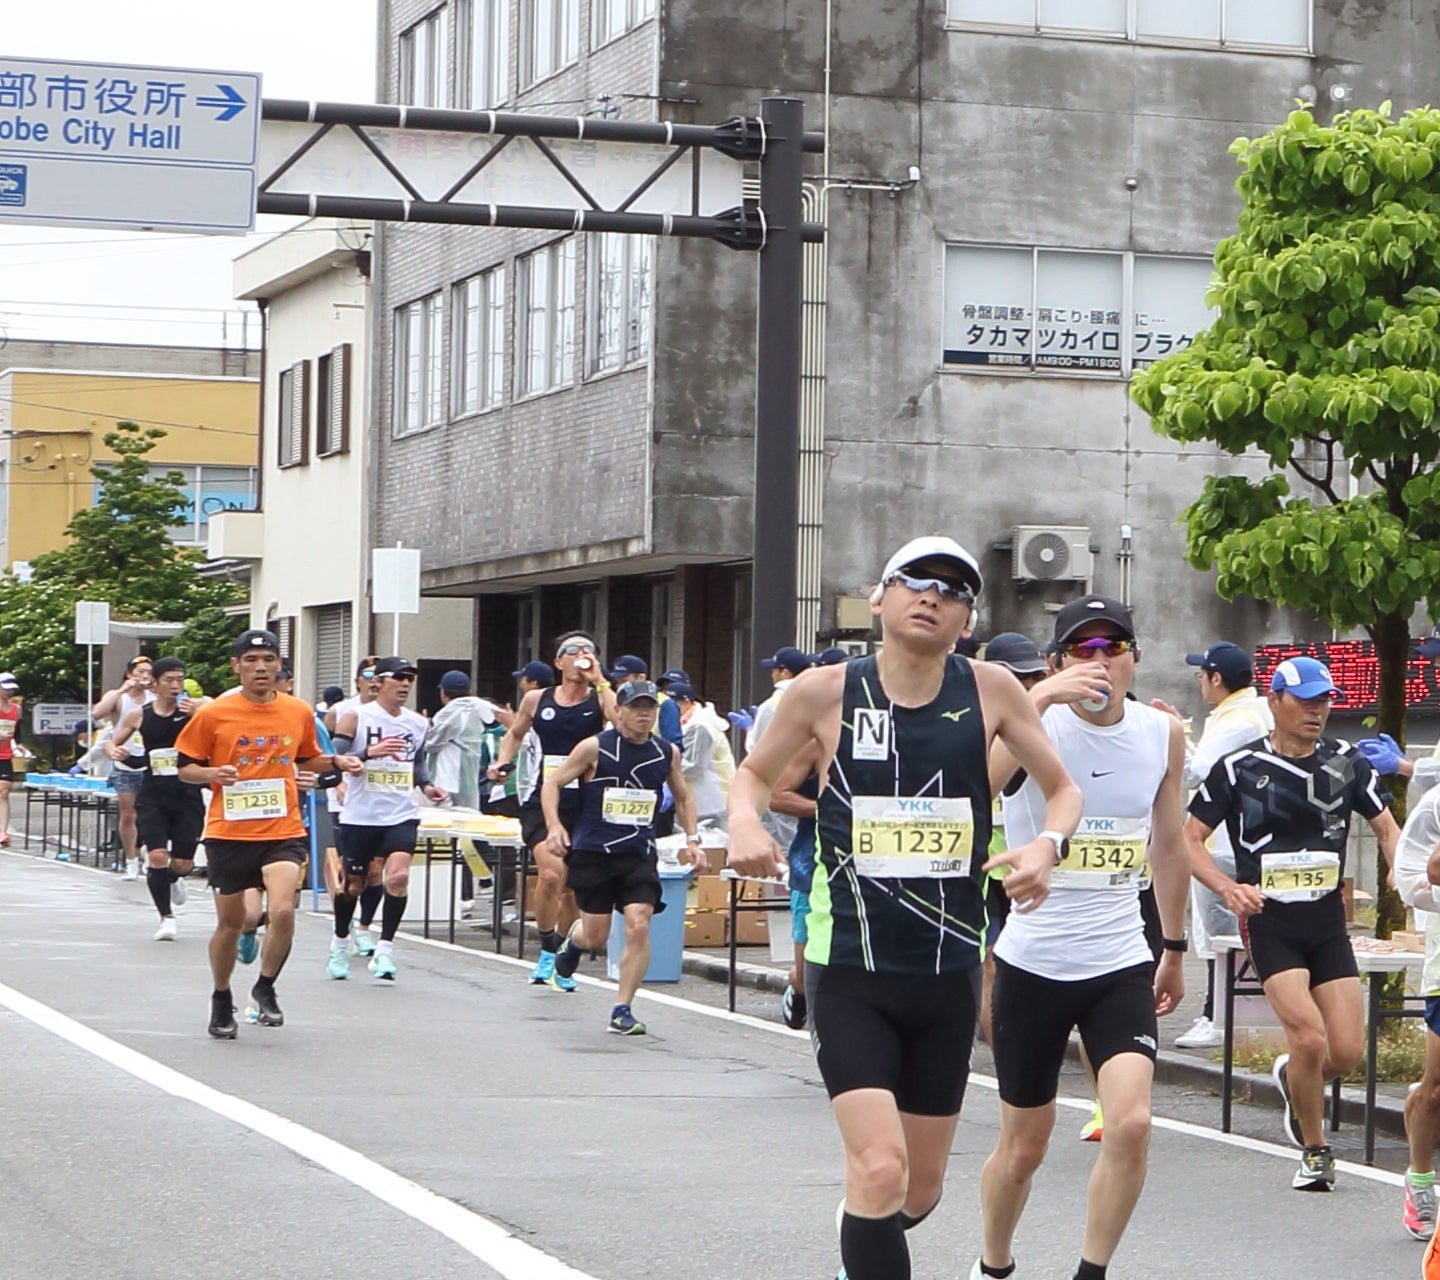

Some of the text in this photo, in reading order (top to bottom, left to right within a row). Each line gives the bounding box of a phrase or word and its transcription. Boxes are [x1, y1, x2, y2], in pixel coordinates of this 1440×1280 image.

[63, 117, 116, 151] City
[129, 122, 181, 150] Hall
[382, 774, 409, 784] 1371
[226, 794, 279, 810] B 1238
[604, 802, 650, 814] B 1275
[897, 799, 935, 812] YKK
[1084, 819, 1116, 831] YKK
[859, 830, 962, 854] B 1237
[1080, 846, 1136, 869] 1342
[1290, 854, 1313, 863] YKK
[1265, 871, 1325, 889] A 135
